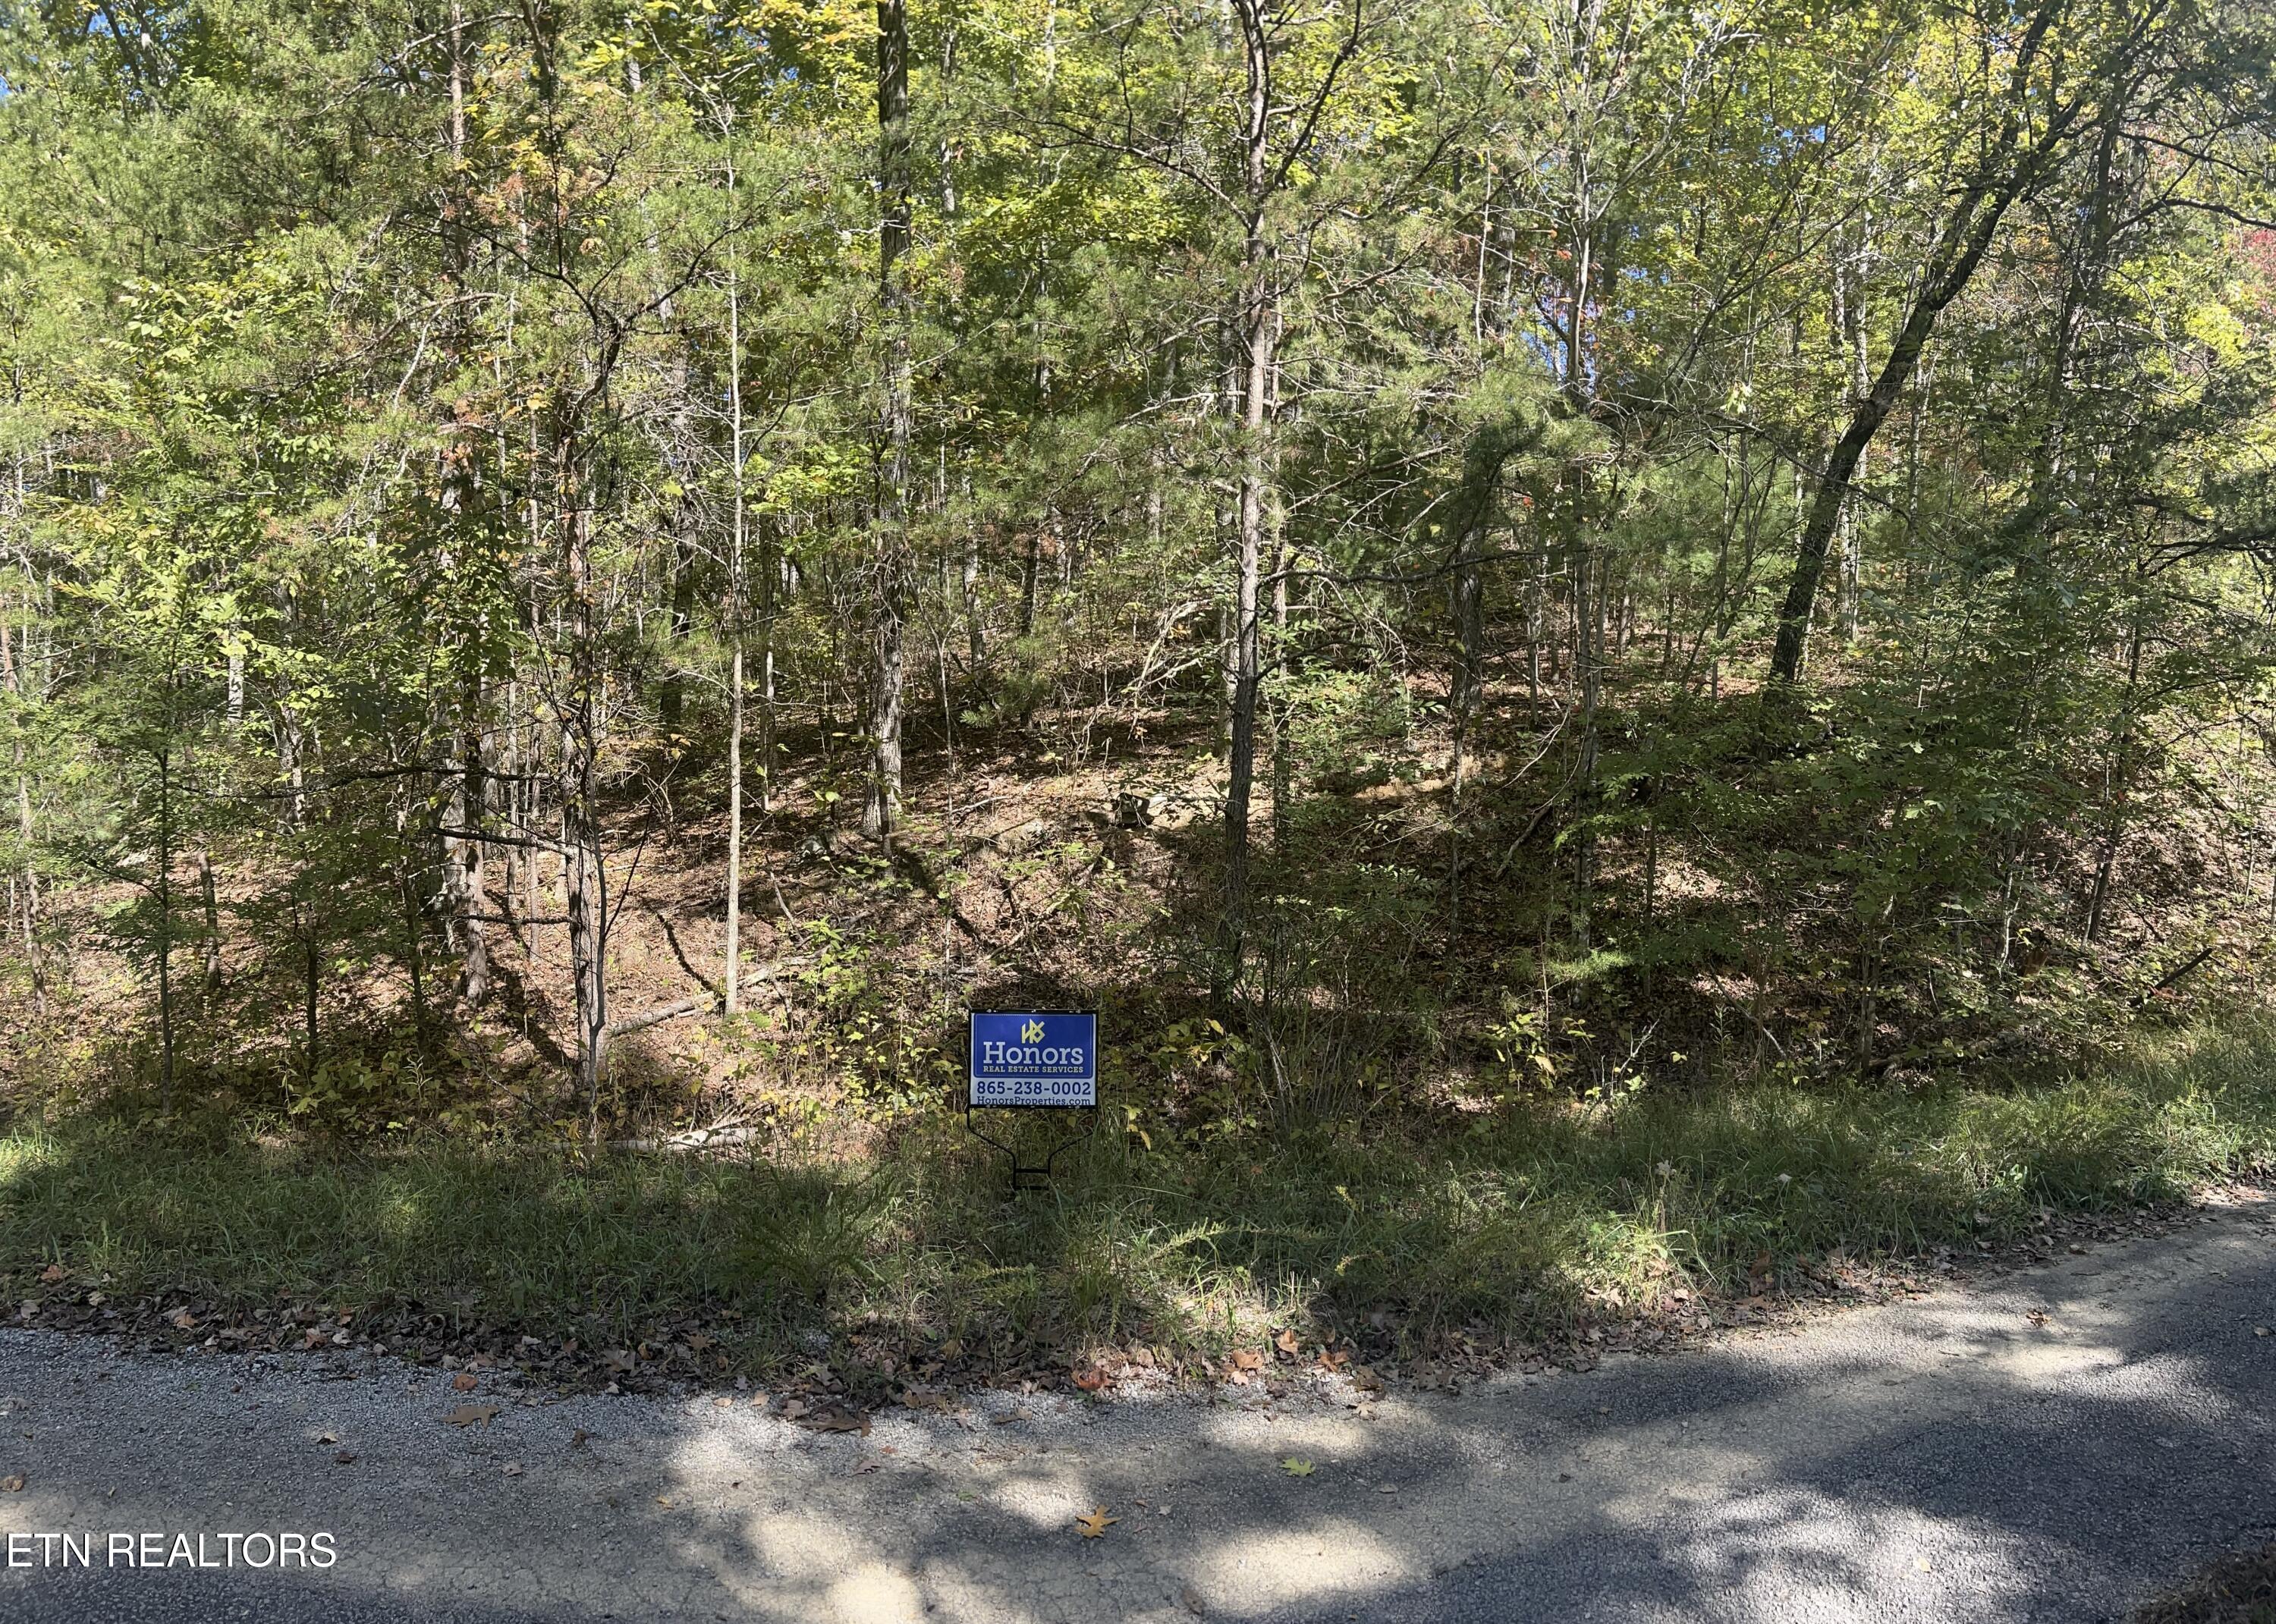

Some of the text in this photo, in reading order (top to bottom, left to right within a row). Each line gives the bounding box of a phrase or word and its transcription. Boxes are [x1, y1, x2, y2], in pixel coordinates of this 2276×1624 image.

[983, 1041, 1083, 1065] Honors
[977, 1081, 1091, 1095] 865-238-0002
[977, 1096, 1091, 1105] HonorsProperties.com
